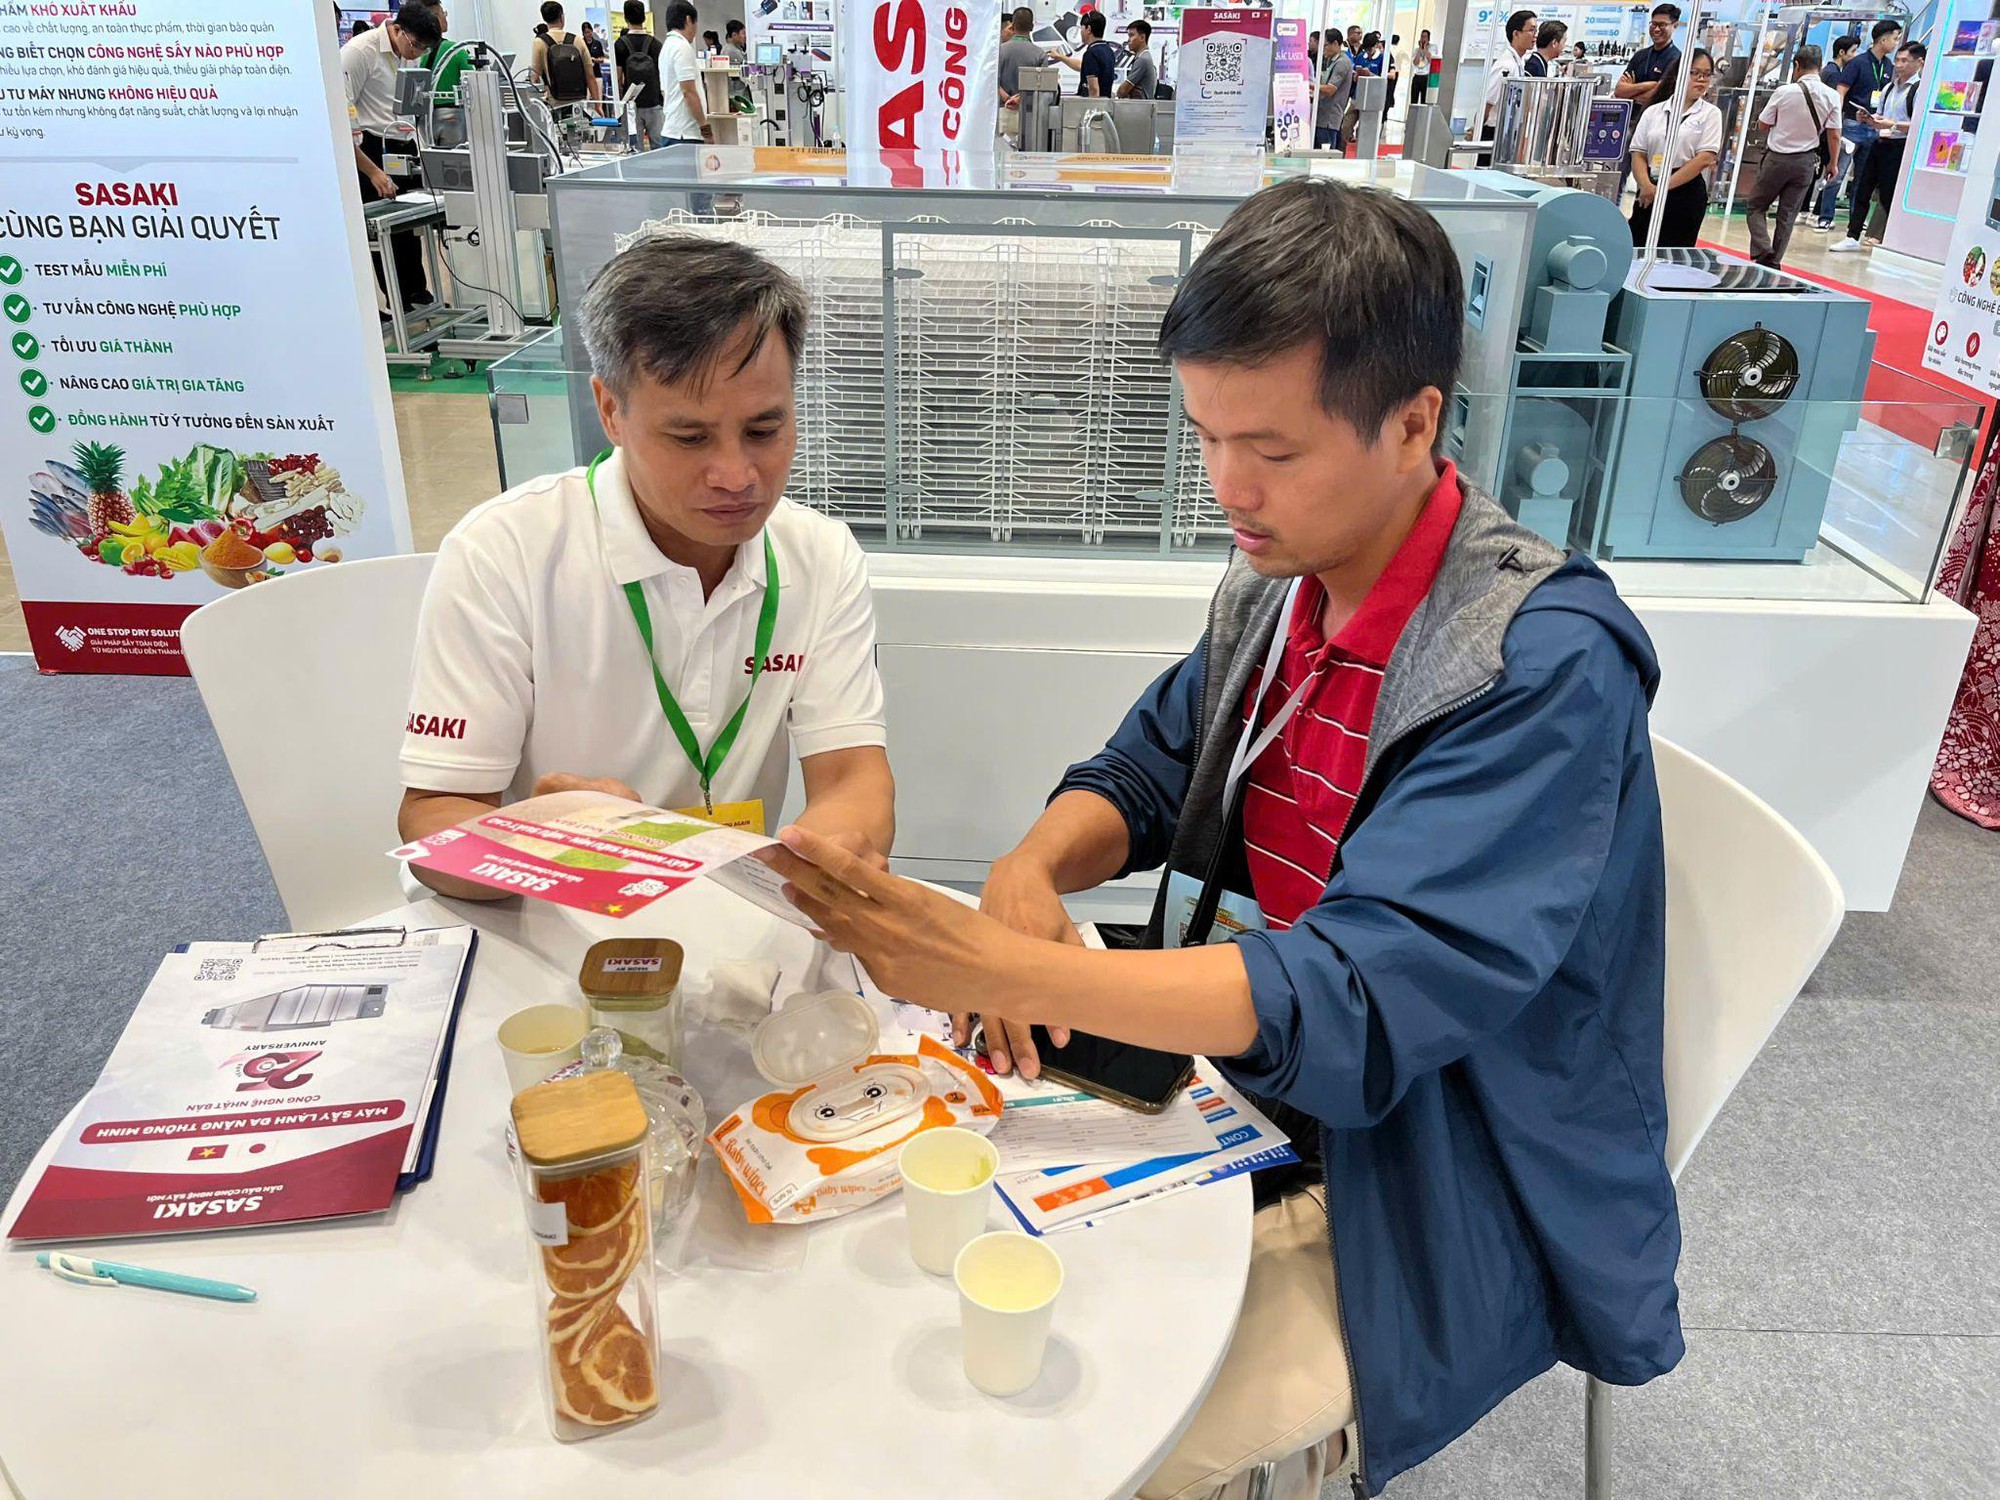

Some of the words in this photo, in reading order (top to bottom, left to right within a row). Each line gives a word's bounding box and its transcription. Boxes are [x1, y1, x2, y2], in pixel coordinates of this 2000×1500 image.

[17, 41, 44, 58] BIẾT
[48, 47, 84, 62] CHỌN
[88, 44, 124, 58] CÔNG
[127, 44, 164, 62] NGHỆ
[166, 40, 192, 58] SẤY
[195, 43, 222, 58] NÀO
[226, 43, 253, 58] PHÙ
[256, 46, 284, 61] HỢP
[938, 7, 968, 140] CÔNG
[7, 88, 26, 100] TƯ
[28, 86, 55, 100] MÁY
[58, 88, 106, 100] NHƯNG
[108, 85, 154, 100] KHÔNG
[157, 85, 187, 103] HIỆU
[190, 84, 218, 100] QUẢ
[75, 182, 179, 206] SASAKI
[69, 215, 126, 244] BẠN
[132, 206, 185, 238] GIẢI
[191, 205, 280, 240] QUYẾT
[35, 264, 69, 276] TEST
[72, 258, 103, 276] MẪU
[106, 258, 142, 276] MIỄN
[143, 261, 168, 277] PHÍ
[43, 302, 62, 314] TƯ
[66, 298, 94, 314] VẤN
[97, 300, 136, 315] CÔNG
[138, 300, 177, 320] NGHỆ
[179, 301, 210, 316] PHÙ
[212, 303, 242, 320] HỢP
[51, 335, 74, 352] TỐI
[76, 340, 98, 352] ƯU
[100, 338, 124, 353] GIÁ
[124, 338, 174, 354] THÀNH
[60, 375, 99, 390] NÂNG
[101, 378, 129, 390] CAO
[132, 375, 156, 391] GIÁ
[156, 378, 180, 394] TRỊ
[182, 379, 206, 392] GIA
[207, 377, 245, 393] TĂNG
[68, 408, 107, 426] ĐỒNG
[110, 412, 148, 427] HÀNH
[150, 412, 170, 427] TỪ
[171, 413, 182, 428] Ý
[235, 412, 264, 430] ĐẾN
[298, 412, 335, 432] XUẤT
[88, 628, 106, 636] ONE
[107, 628, 131, 636] STOP
[132, 628, 150, 637] DRY
[469, 862, 559, 891] SASAKI
[244, 1040, 327, 1052] ANNIVERSARY
[236, 1050, 323, 1092] 25
[214, 1100, 248, 1110] NHẬT
[251, 1096, 284, 1107] NGHỆ
[287, 1094, 321, 1103] CÔNG
[186, 1104, 212, 1113] BẢN
[356, 1106, 388, 1119] MÁY
[249, 1116, 272, 1126] ĐA
[274, 1112, 318, 1126] LẠNH
[320, 1109, 353, 1123] SẤY
[143, 1122, 198, 1135] THÔNG
[201, 1118, 248, 1130] NĂNG
[96, 1126, 139, 1138] MINH
[1220, 1130, 1250, 1146] CONT
[742, 1163, 768, 1196] wipes
[188, 1190, 214, 1199] NGHỆ
[215, 1188, 240, 1196] CÔNG
[240, 1186, 262, 1195] ĐẦU
[263, 1184, 284, 1193] DẪN
[840, 1184, 866, 1196] wipes
[154, 1196, 264, 1218] SASAKI
